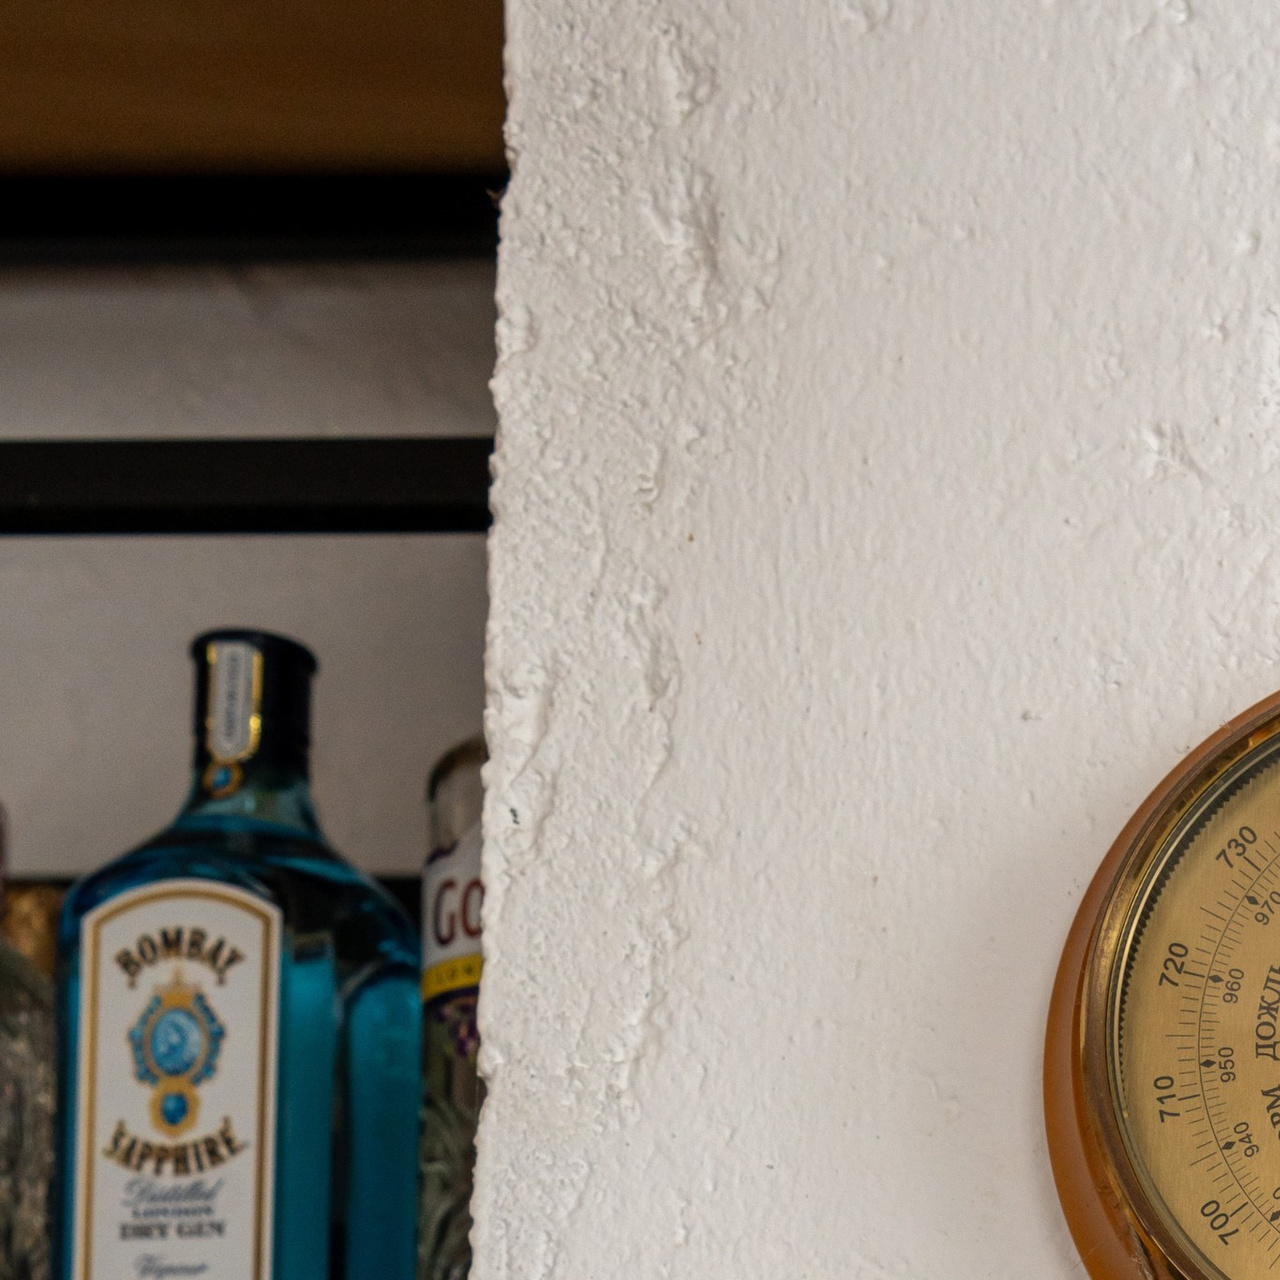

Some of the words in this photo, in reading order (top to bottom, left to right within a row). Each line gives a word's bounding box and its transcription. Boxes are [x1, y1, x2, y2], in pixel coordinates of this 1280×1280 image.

[1215, 825, 1258, 869] 730
[114, 926, 246, 988] BOMBAY
[1158, 942, 1189, 988] 720
[1222, 968, 1245, 1004] 960
[1218, 1047, 1236, 1083] 950
[1153, 1075, 1181, 1123] 710
[102, 1115, 250, 1176] SAPPHIRE
[1233, 1121, 1260, 1158] 940
[1200, 1200, 1239, 1246] 700
